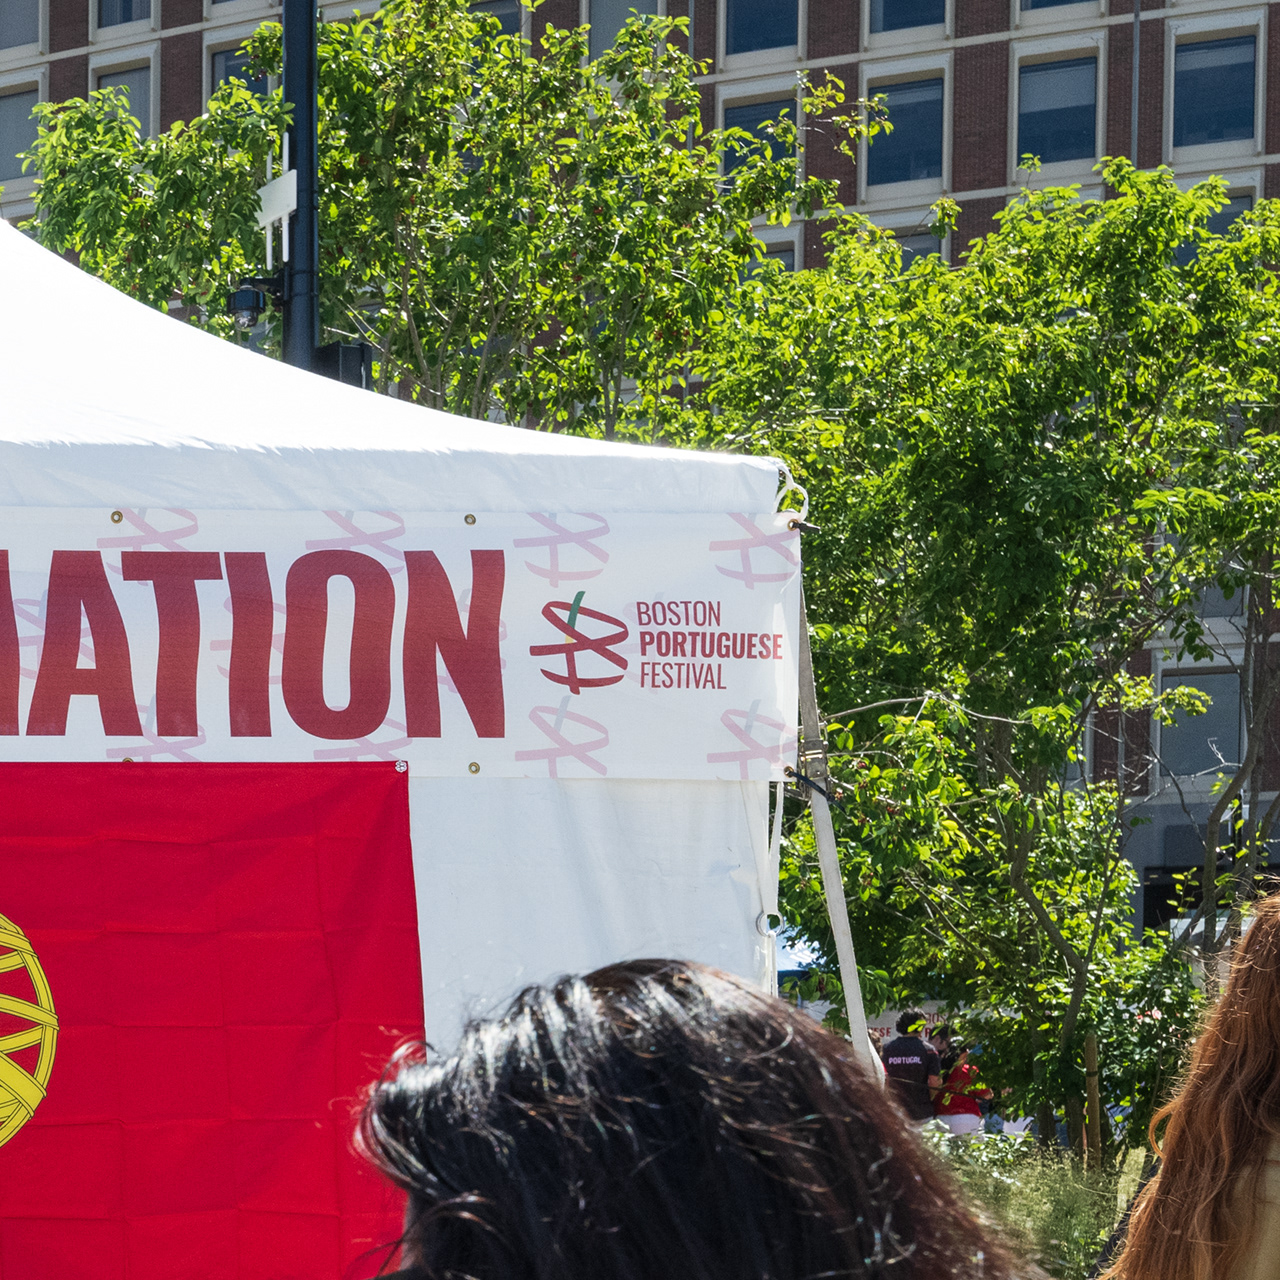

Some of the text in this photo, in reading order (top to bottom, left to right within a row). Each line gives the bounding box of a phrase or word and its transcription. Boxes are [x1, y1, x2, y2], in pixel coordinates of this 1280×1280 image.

[636, 600, 721, 627] BOSTON
[639, 630, 783, 660] PORTUGUESE
[640, 662, 727, 690] FESTIVAL
[888, 1056, 922, 1065] PORTUGAL
